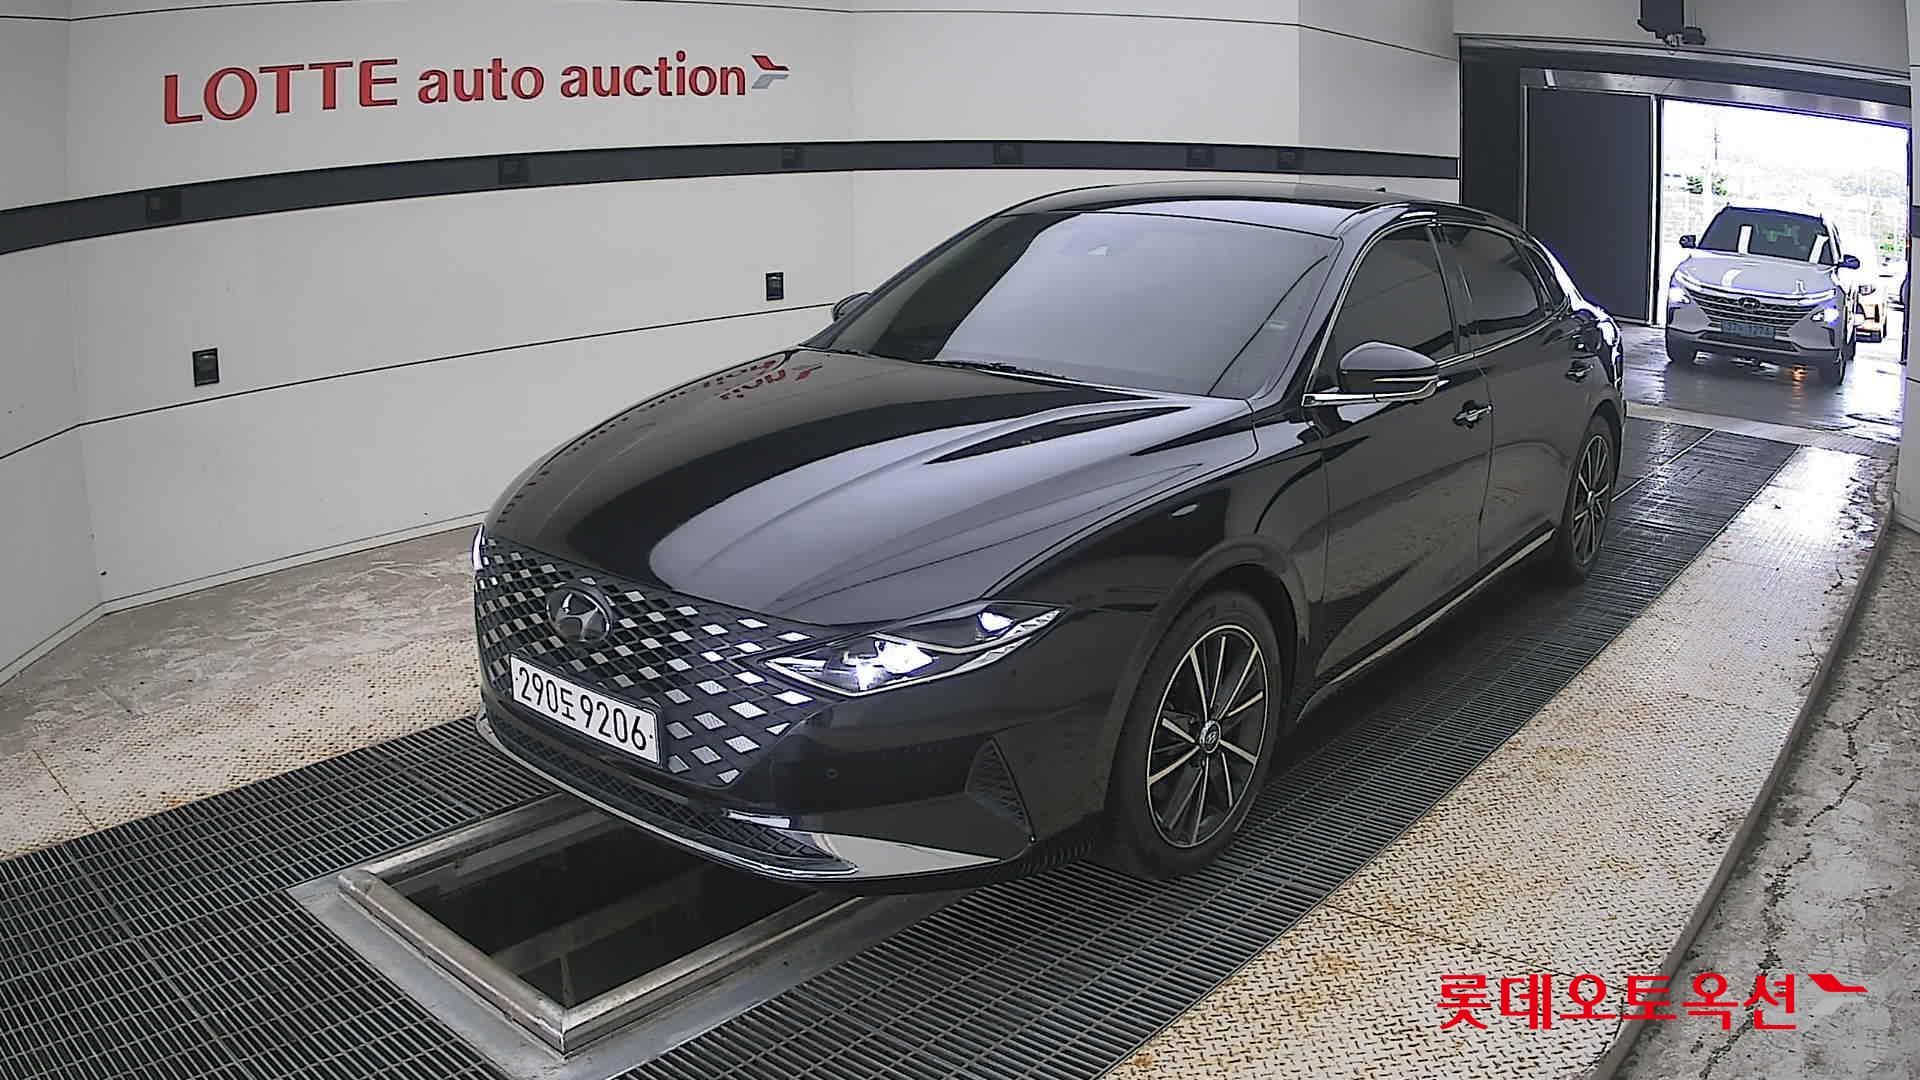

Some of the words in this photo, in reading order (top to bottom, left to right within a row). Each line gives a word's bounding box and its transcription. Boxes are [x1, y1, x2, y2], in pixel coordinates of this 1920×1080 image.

[164, 58, 399, 124] LOTTE
[417, 57, 545, 103] auto
[560, 50, 747, 97] auction
